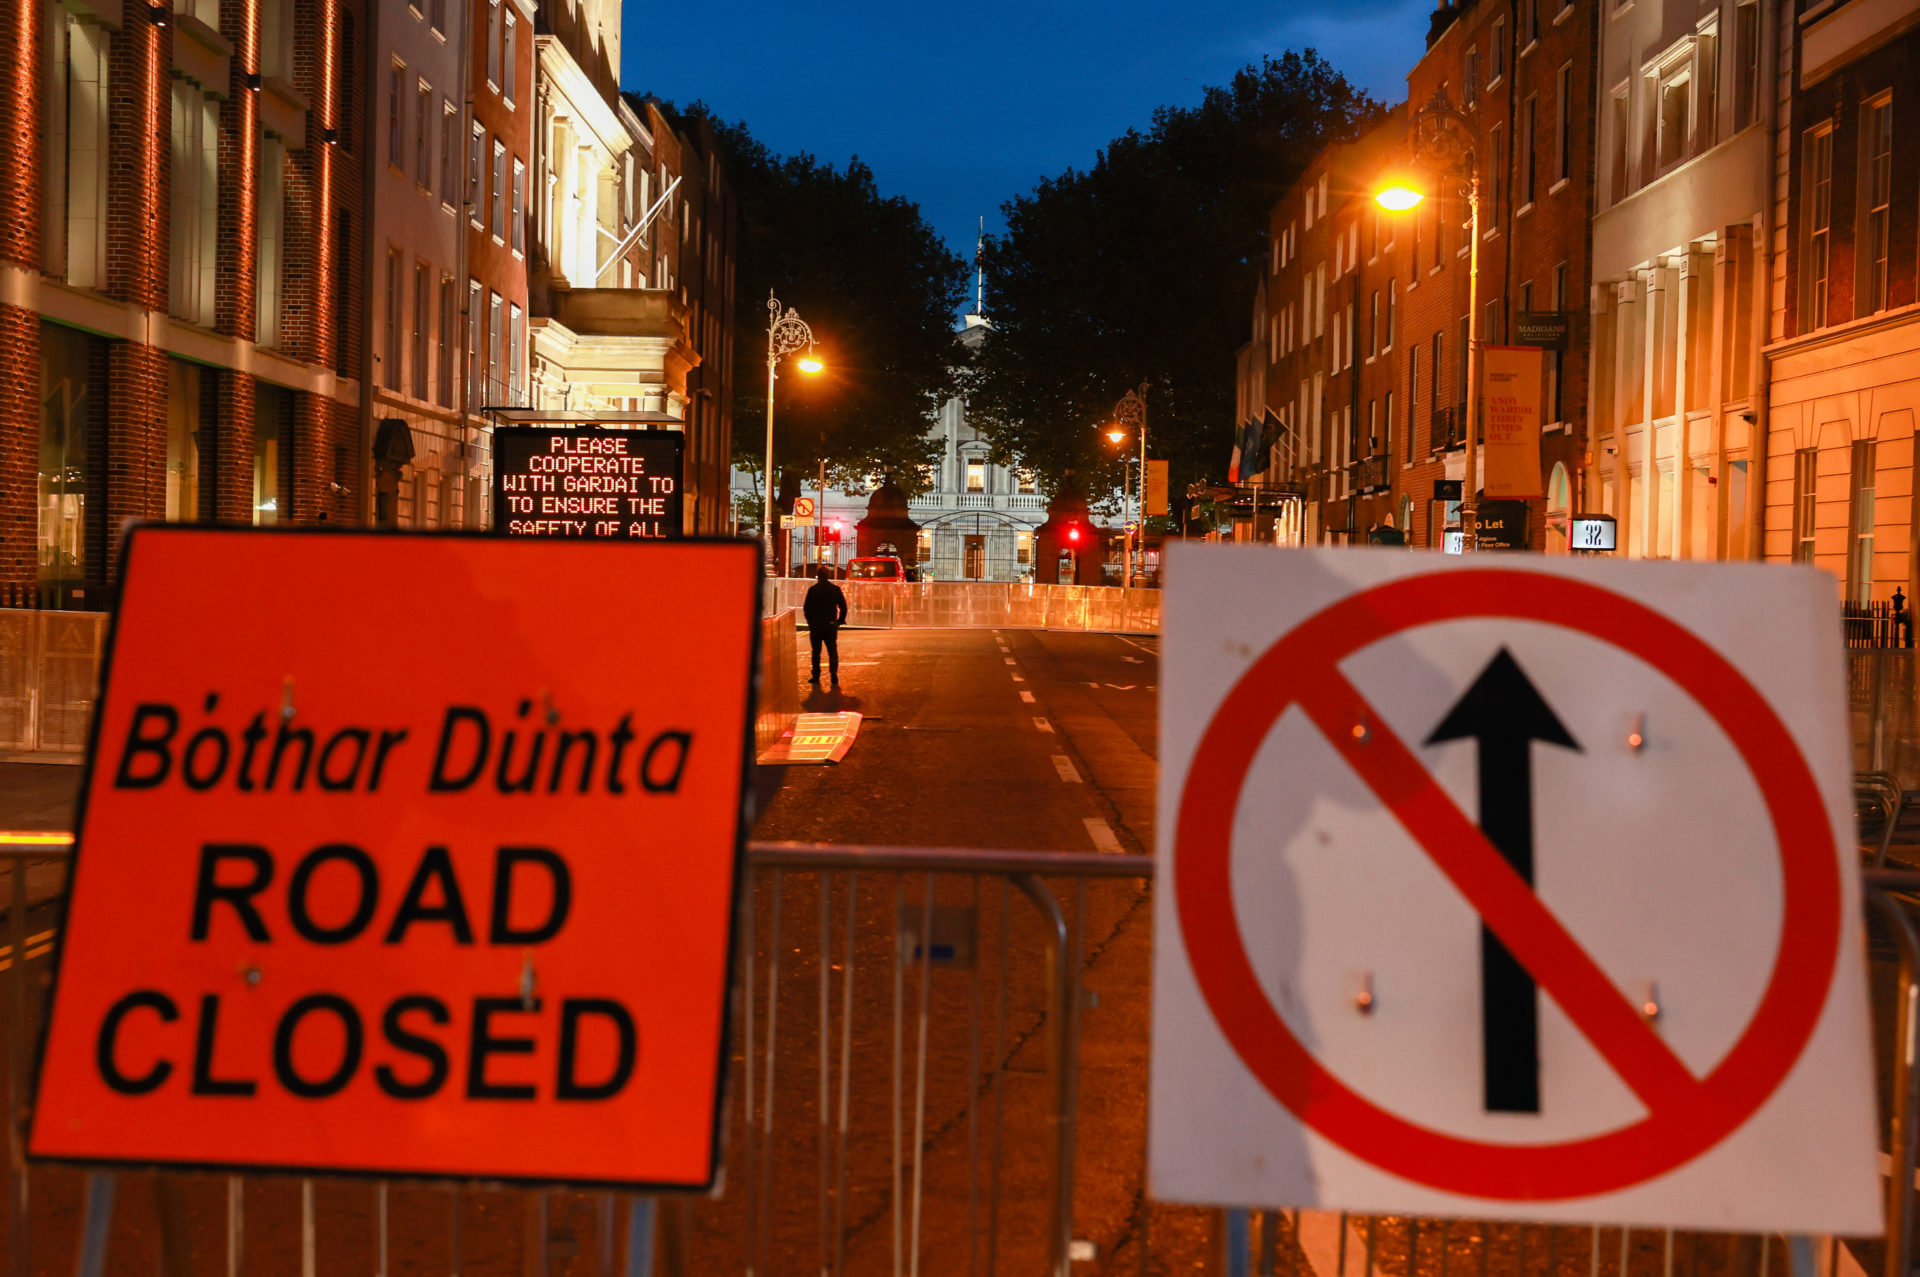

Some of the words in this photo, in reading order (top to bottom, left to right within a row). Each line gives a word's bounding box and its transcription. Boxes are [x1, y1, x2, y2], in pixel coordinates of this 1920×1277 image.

[1490, 397, 1518, 405] ANDY
[1489, 406, 1535, 415] WARHOL
[1490, 415, 1523, 423] THREE
[1489, 433, 1512, 441] OUT
[1490, 424, 1523, 432] TIMES
[551, 437, 628, 455] PLEASE
[529, 456, 645, 474] COOPERATE
[503, 475, 555, 492] WITH
[563, 476, 638, 493] GARDAI
[649, 477, 674, 494] TO
[507, 496, 534, 513] TO
[541, 497, 619, 514] ENSURE
[628, 498, 665, 515] THE
[595, 521, 621, 537] OF
[629, 522, 667, 538] ALL
[1485, 519, 1504, 529] Let
[1585, 524, 1602, 546] 32
[113, 692, 408, 794] Bóthar
[427, 697, 694, 795] Dúnta
[190, 843, 573, 946] ROAD
[95, 989, 638, 1102] CLOSED
